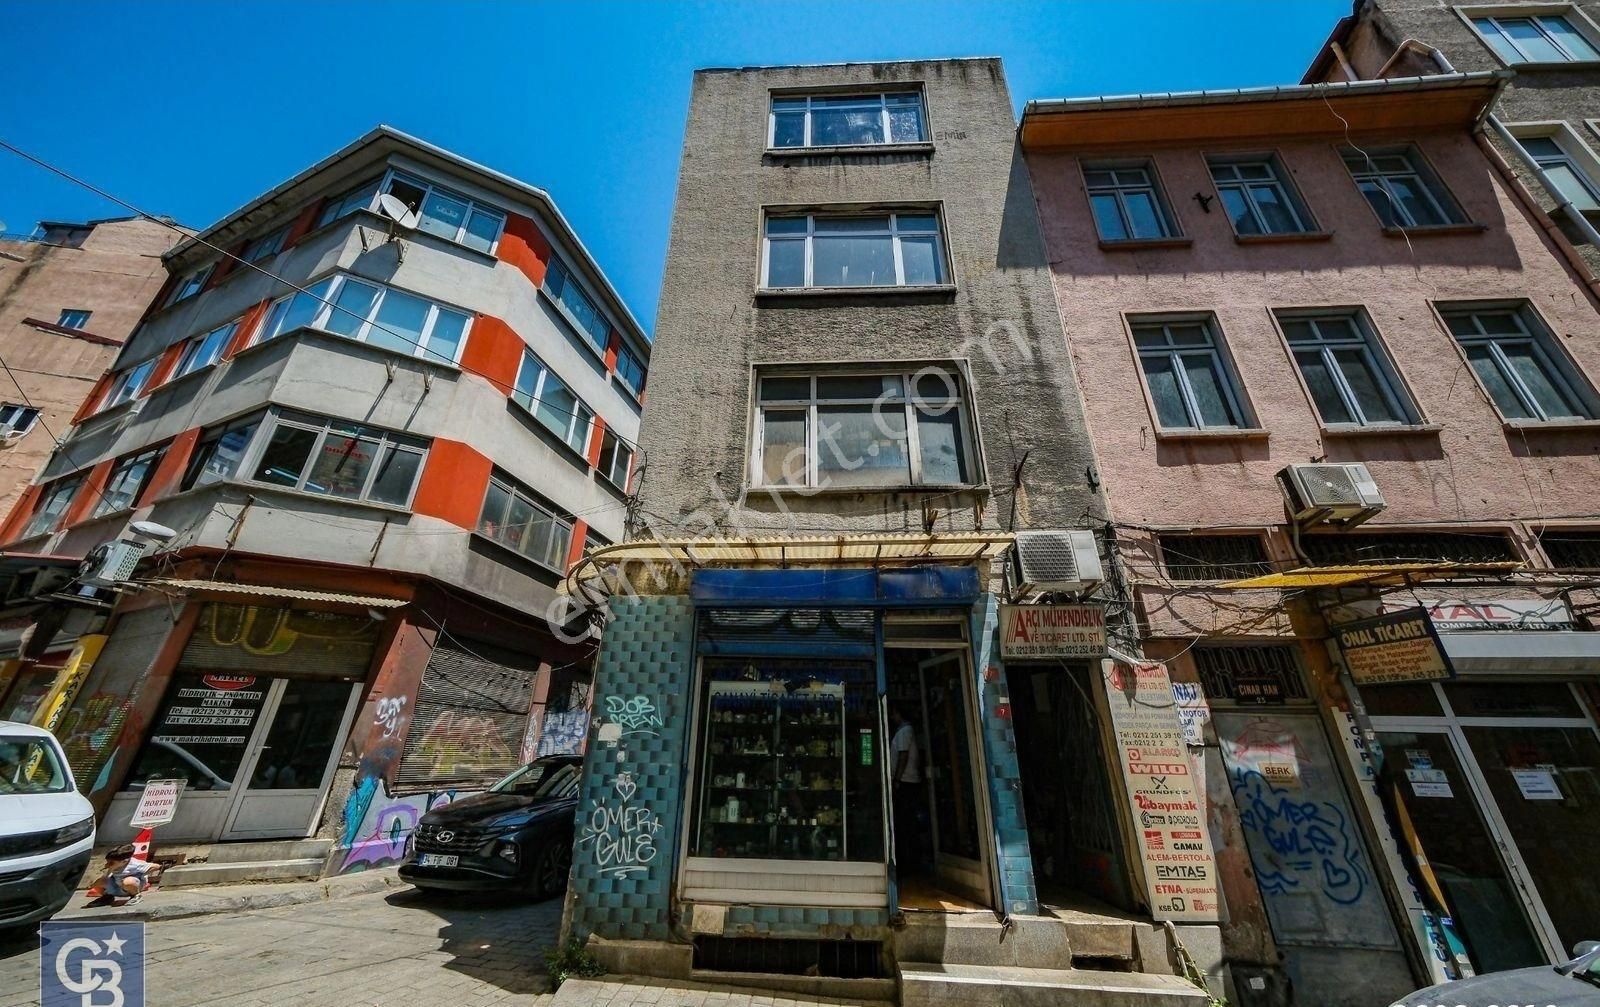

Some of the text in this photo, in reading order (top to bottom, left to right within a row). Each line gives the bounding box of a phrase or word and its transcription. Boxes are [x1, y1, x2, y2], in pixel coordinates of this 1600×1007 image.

[1374, 621, 1427, 642] TİCARET
[1183, 710, 1207, 718] MOTOR
[1131, 764, 1186, 774] WILO
[1265, 766, 1290, 775] BERK
[1155, 884, 1183, 894] ETNA
